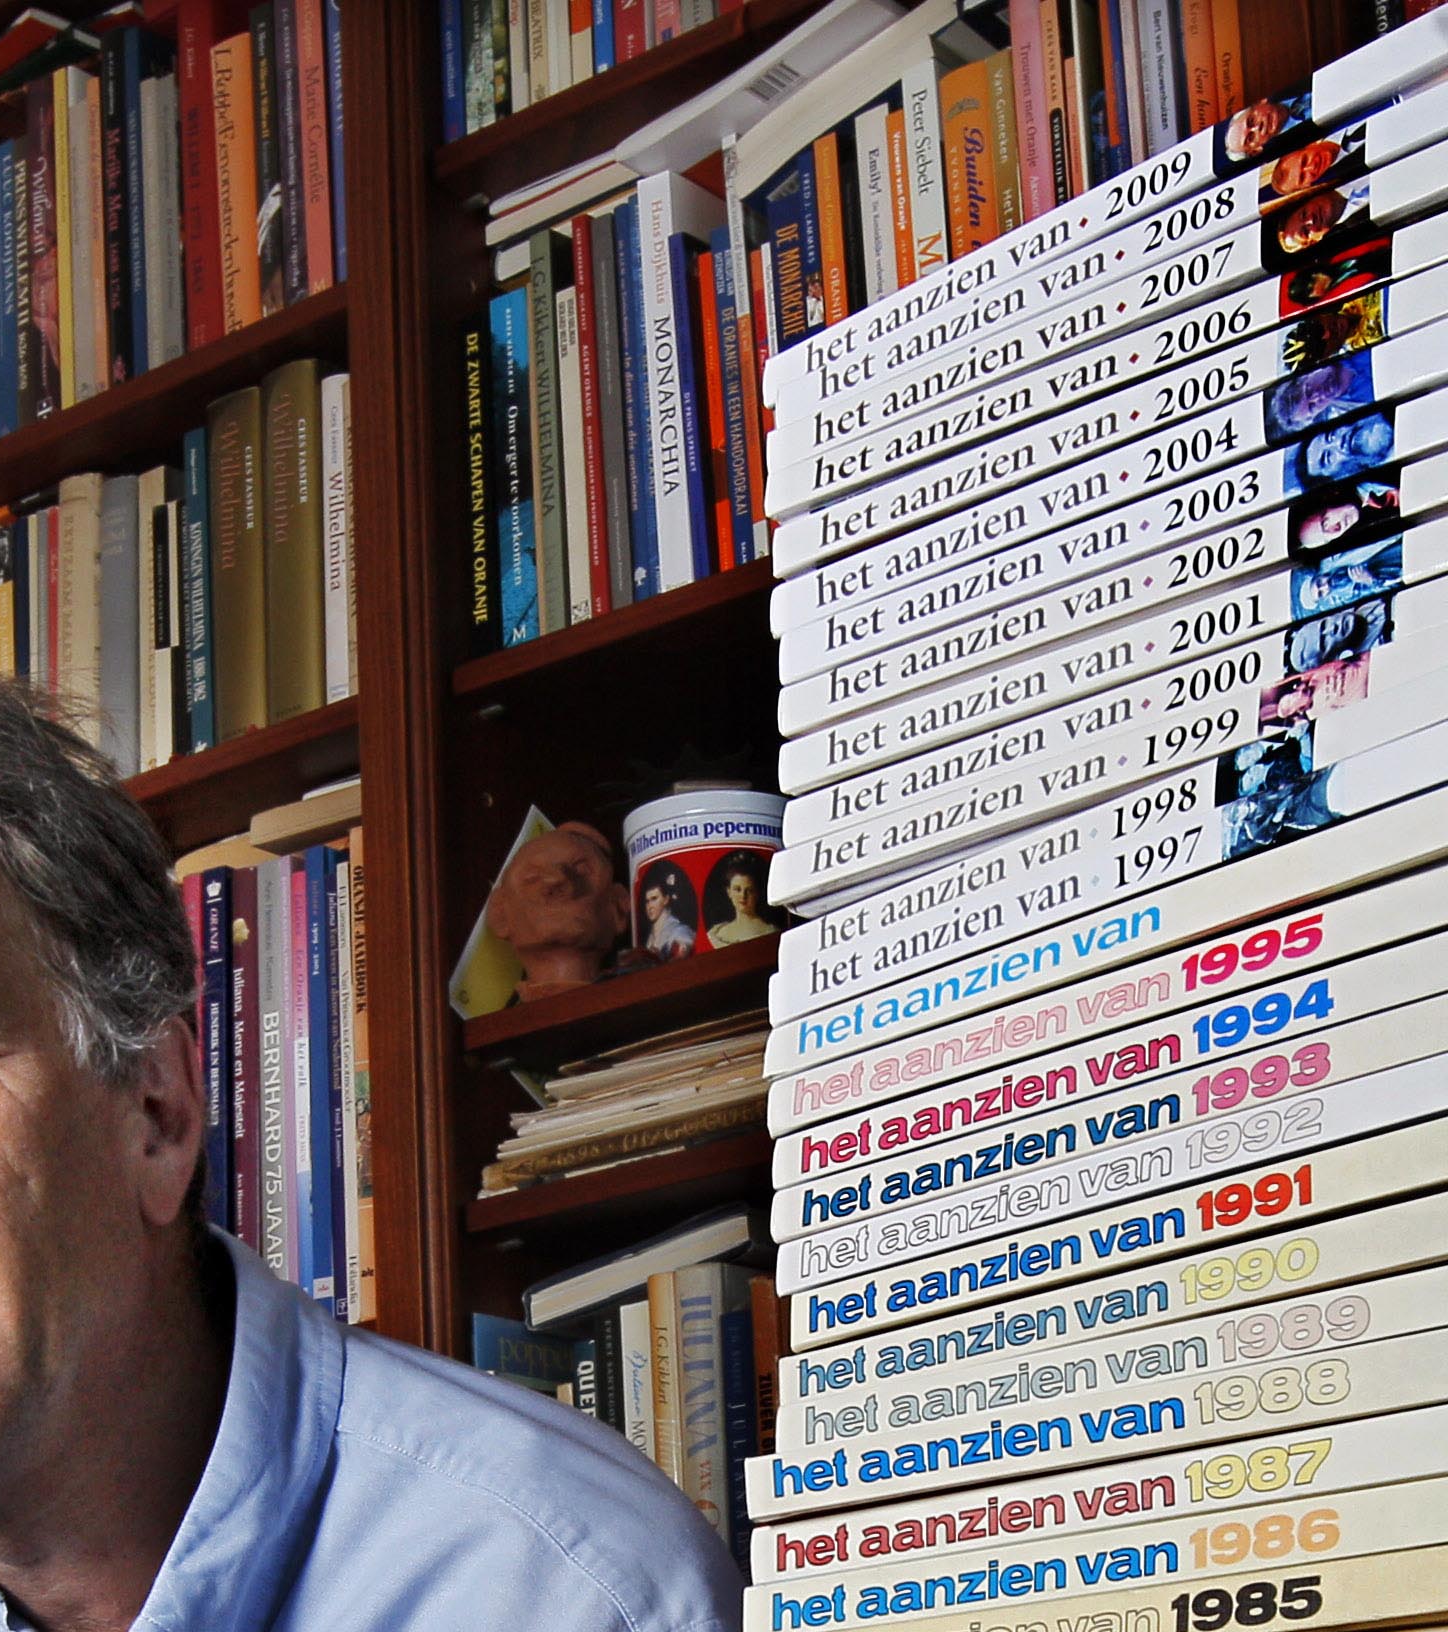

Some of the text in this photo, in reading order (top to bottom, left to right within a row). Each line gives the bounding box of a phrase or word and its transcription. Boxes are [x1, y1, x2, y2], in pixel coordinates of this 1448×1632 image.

[305, 64, 320, 121] Marie
[912, 88, 935, 196] Peter Siebelt
[993, 70, 1008, 163] Van Ginneken
[1020, 42, 1036, 167] Trouwen met Oranje
[651, 200, 663, 245] Hans
[775, 222, 806, 340] DE MONARCHIE
[806, 152, 1191, 374] het aanzien van 2009
[506, 435, 518, 476] erger
[654, 316, 680, 497] MONARCHIA
[329, 473, 345, 591] Wilhelmina
[467, 333, 488, 624] DE ZWARTE SCHAPEN VAN ORANJE
[511, 479, 518, 495] te
[815, 418, 1239, 608] het aanzien van 2004
[511, 499, 522, 587] voorkomen
[233, 1020, 244, 1056] Mens
[793, 913, 1325, 1115] het aanzien van 1995
[798, 906, 1161, 1055] het aanzien van
[234, 1077, 245, 1139] Majesteit
[235, 1059, 244, 1074] en
[264, 1011, 284, 1270] BERNHARD 75 JAAR
[808, 1164, 1313, 1333] het aanzien van 1991
[680, 1296, 717, 1458] JULIANA
